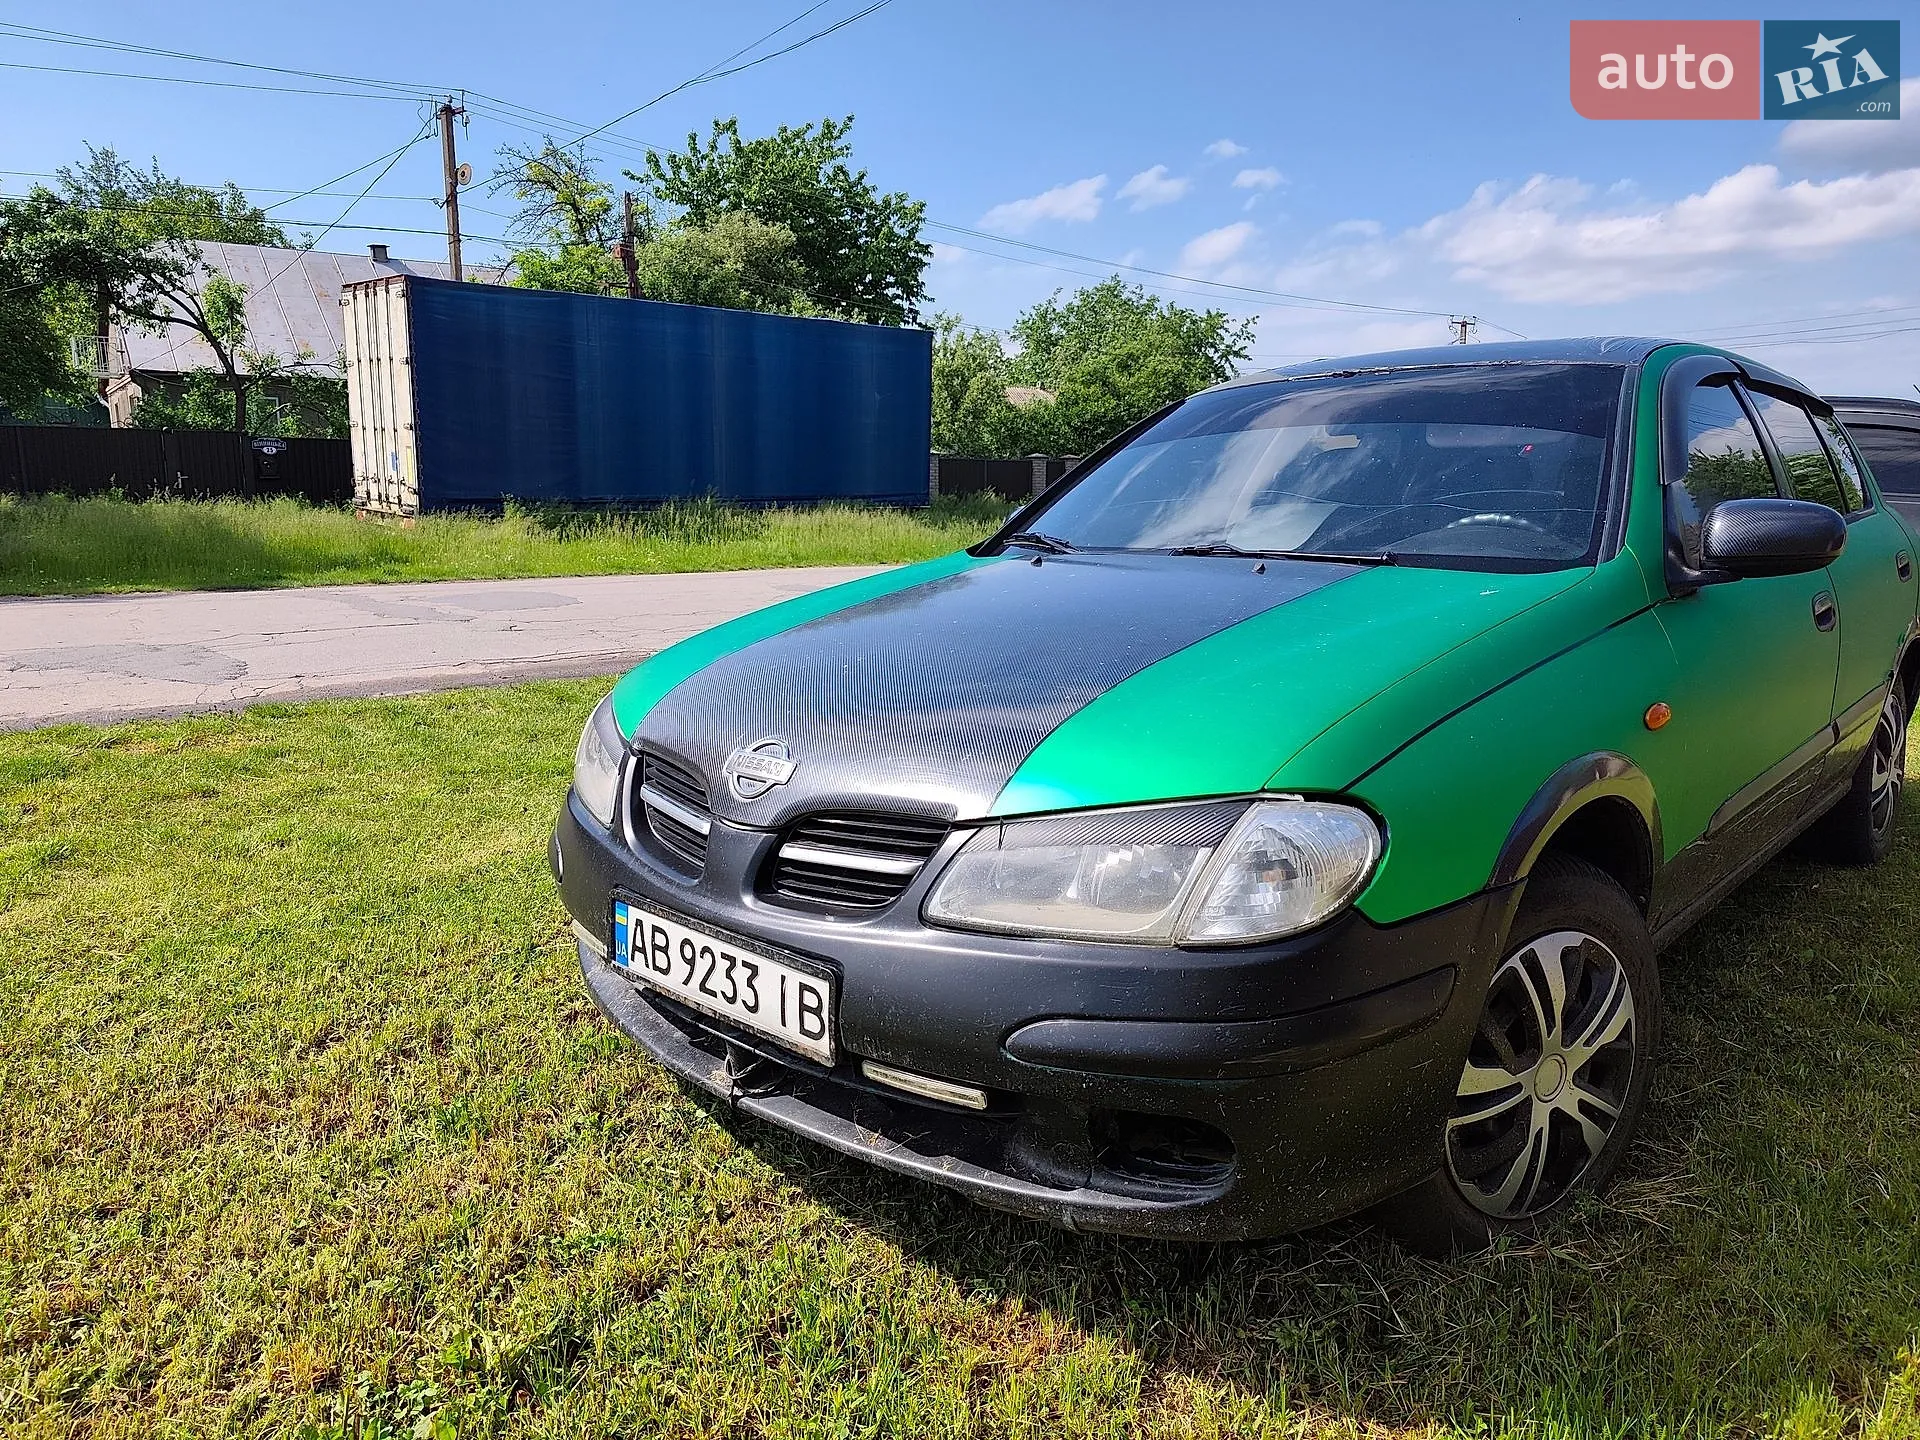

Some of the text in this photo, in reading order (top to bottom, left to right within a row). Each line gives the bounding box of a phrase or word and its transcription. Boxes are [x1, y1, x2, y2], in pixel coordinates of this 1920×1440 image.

[733, 754, 785, 777] NISSAN
[616, 939, 628, 957] UA
[631, 918, 825, 1041] AB 9233 IB
